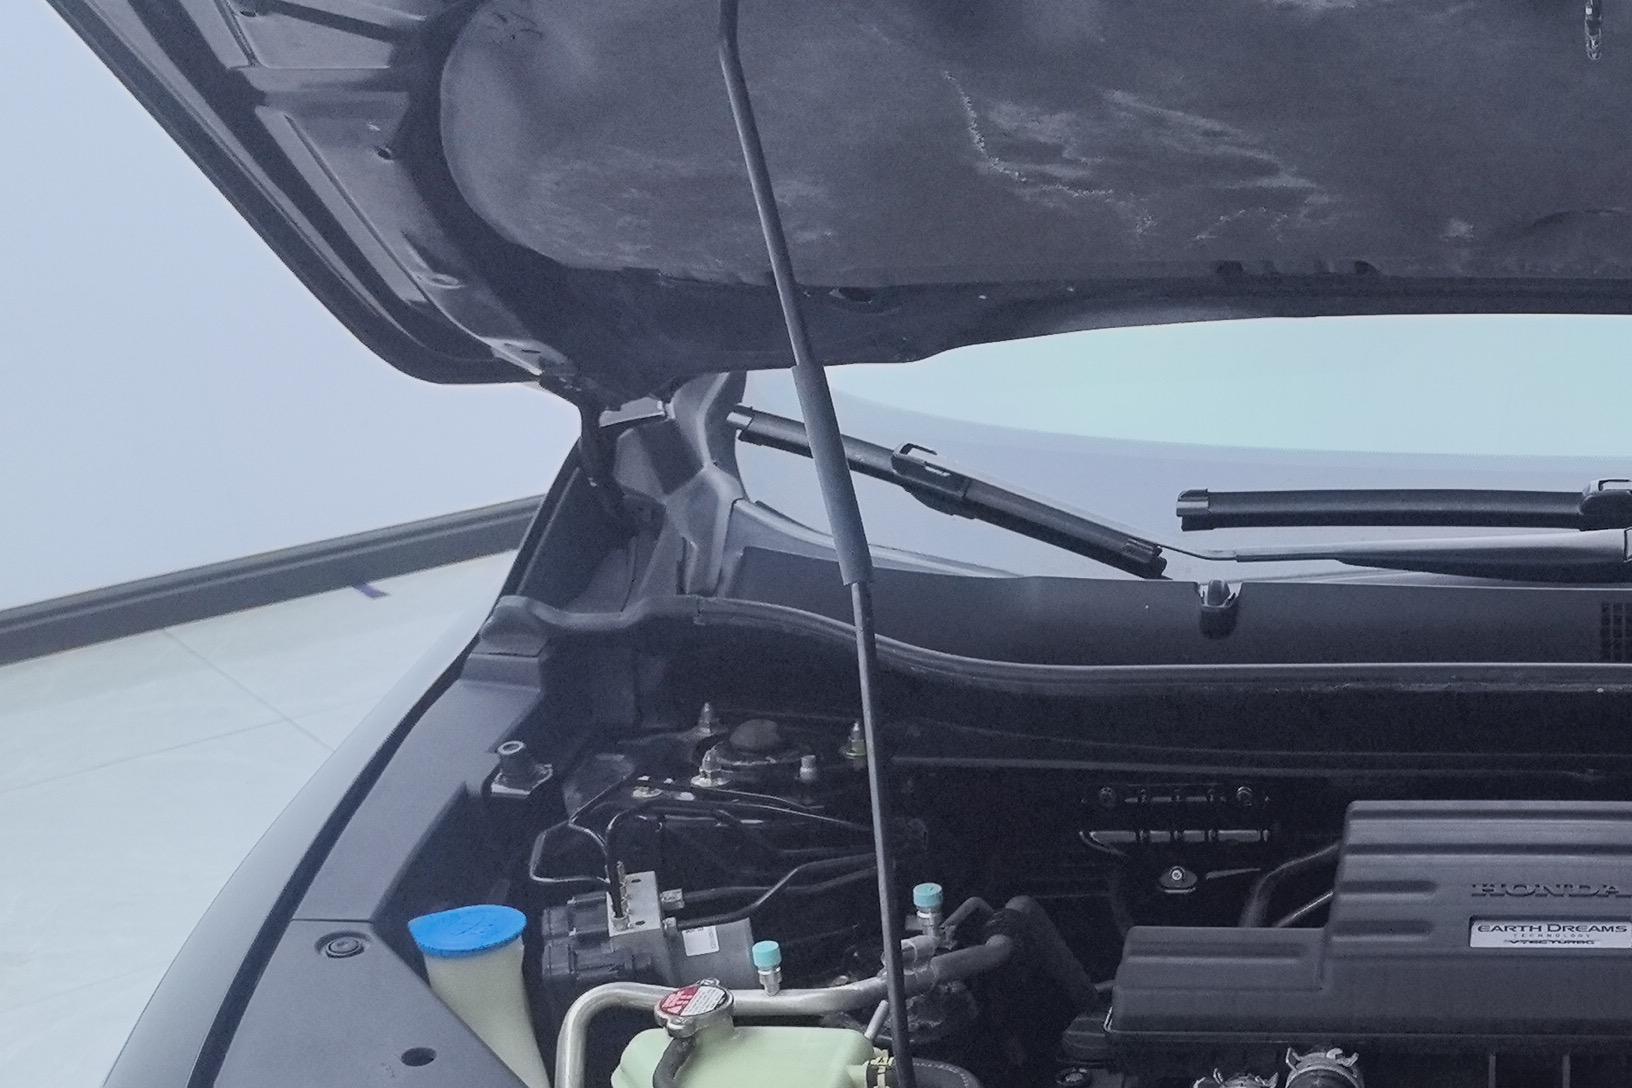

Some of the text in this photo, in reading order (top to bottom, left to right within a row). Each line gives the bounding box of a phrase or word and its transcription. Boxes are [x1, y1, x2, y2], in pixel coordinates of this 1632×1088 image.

[1471, 883, 1632, 898] HONDA
[1477, 923, 1628, 933] EARTH DREAMS
